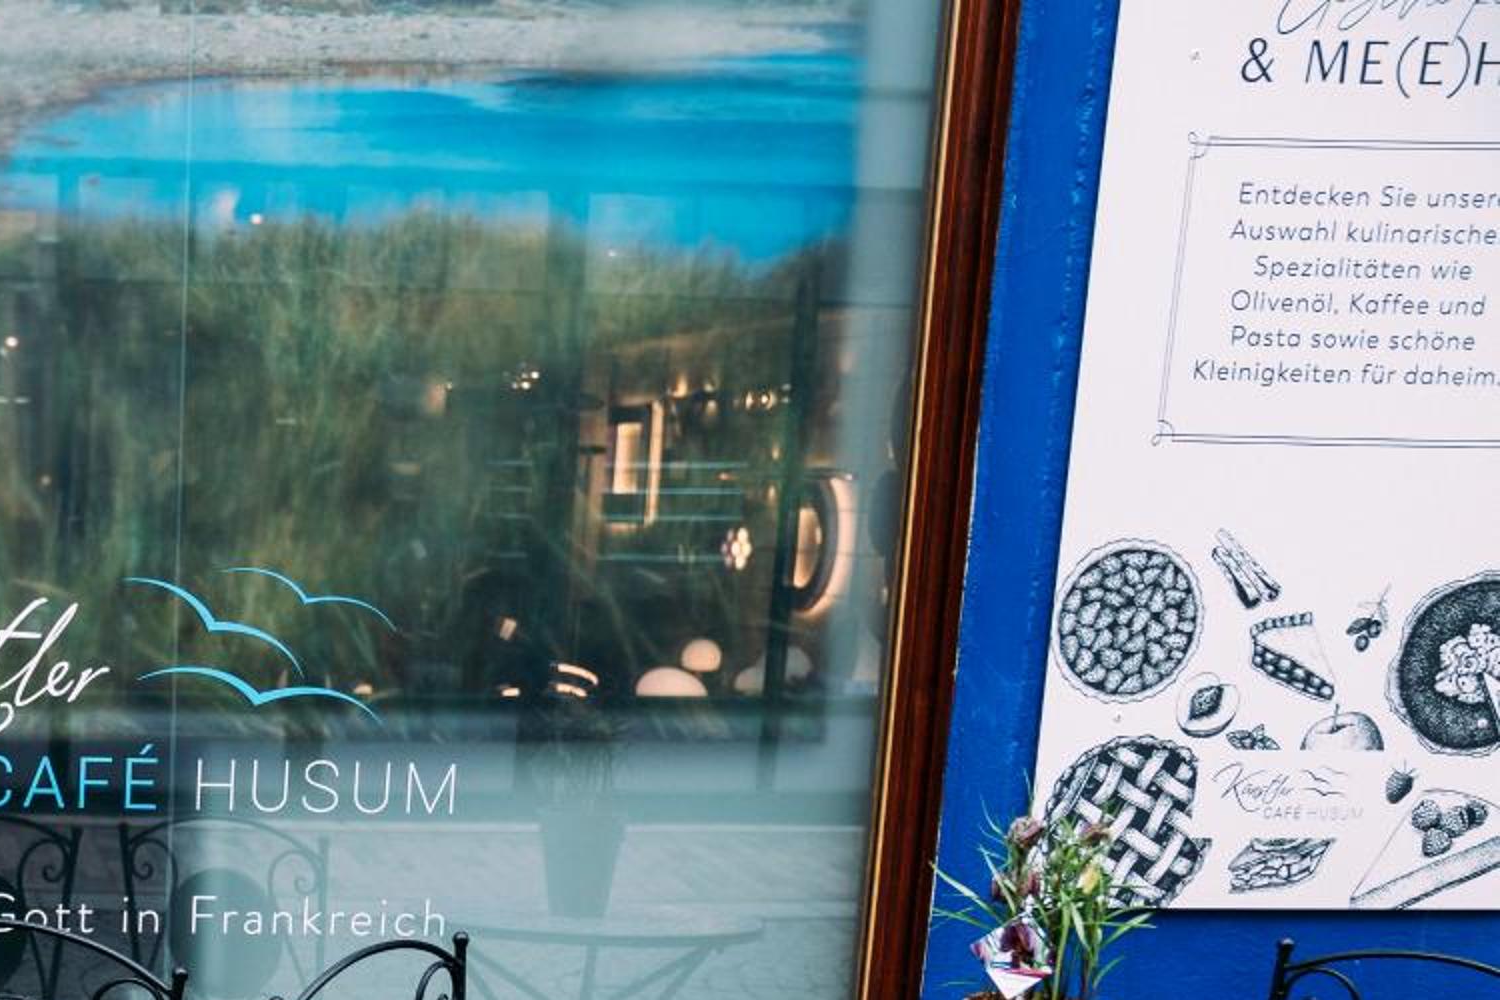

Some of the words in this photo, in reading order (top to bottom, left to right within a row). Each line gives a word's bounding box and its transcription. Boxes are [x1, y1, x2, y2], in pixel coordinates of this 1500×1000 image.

[1240, 37, 1275, 83] &
[1238, 182, 1370, 207] Entdecken
[1380, 185, 1417, 208] Sie
[1427, 192, 1500, 209] unser
[1230, 219, 1337, 242] Auswahl
[1253, 255, 1421, 281] Spezialitäten
[1431, 261, 1473, 281] wie
[1230, 289, 1339, 315] Olivenöl,
[1349, 293, 1430, 316] Kaffee
[1438, 296, 1487, 316] und
[1230, 325, 1302, 348] Pasta
[1311, 329, 1380, 350] sowie
[1388, 329, 1476, 351] schöne
[1192, 359, 1352, 387] Kleinigkeiten
[1361, 363, 1396, 385] für
[1403, 363, 1500, 387] daheim.
[194, 757, 457, 815] HUSUM
[121, 896, 160, 934] in
[190, 895, 446, 938] Frankreich
